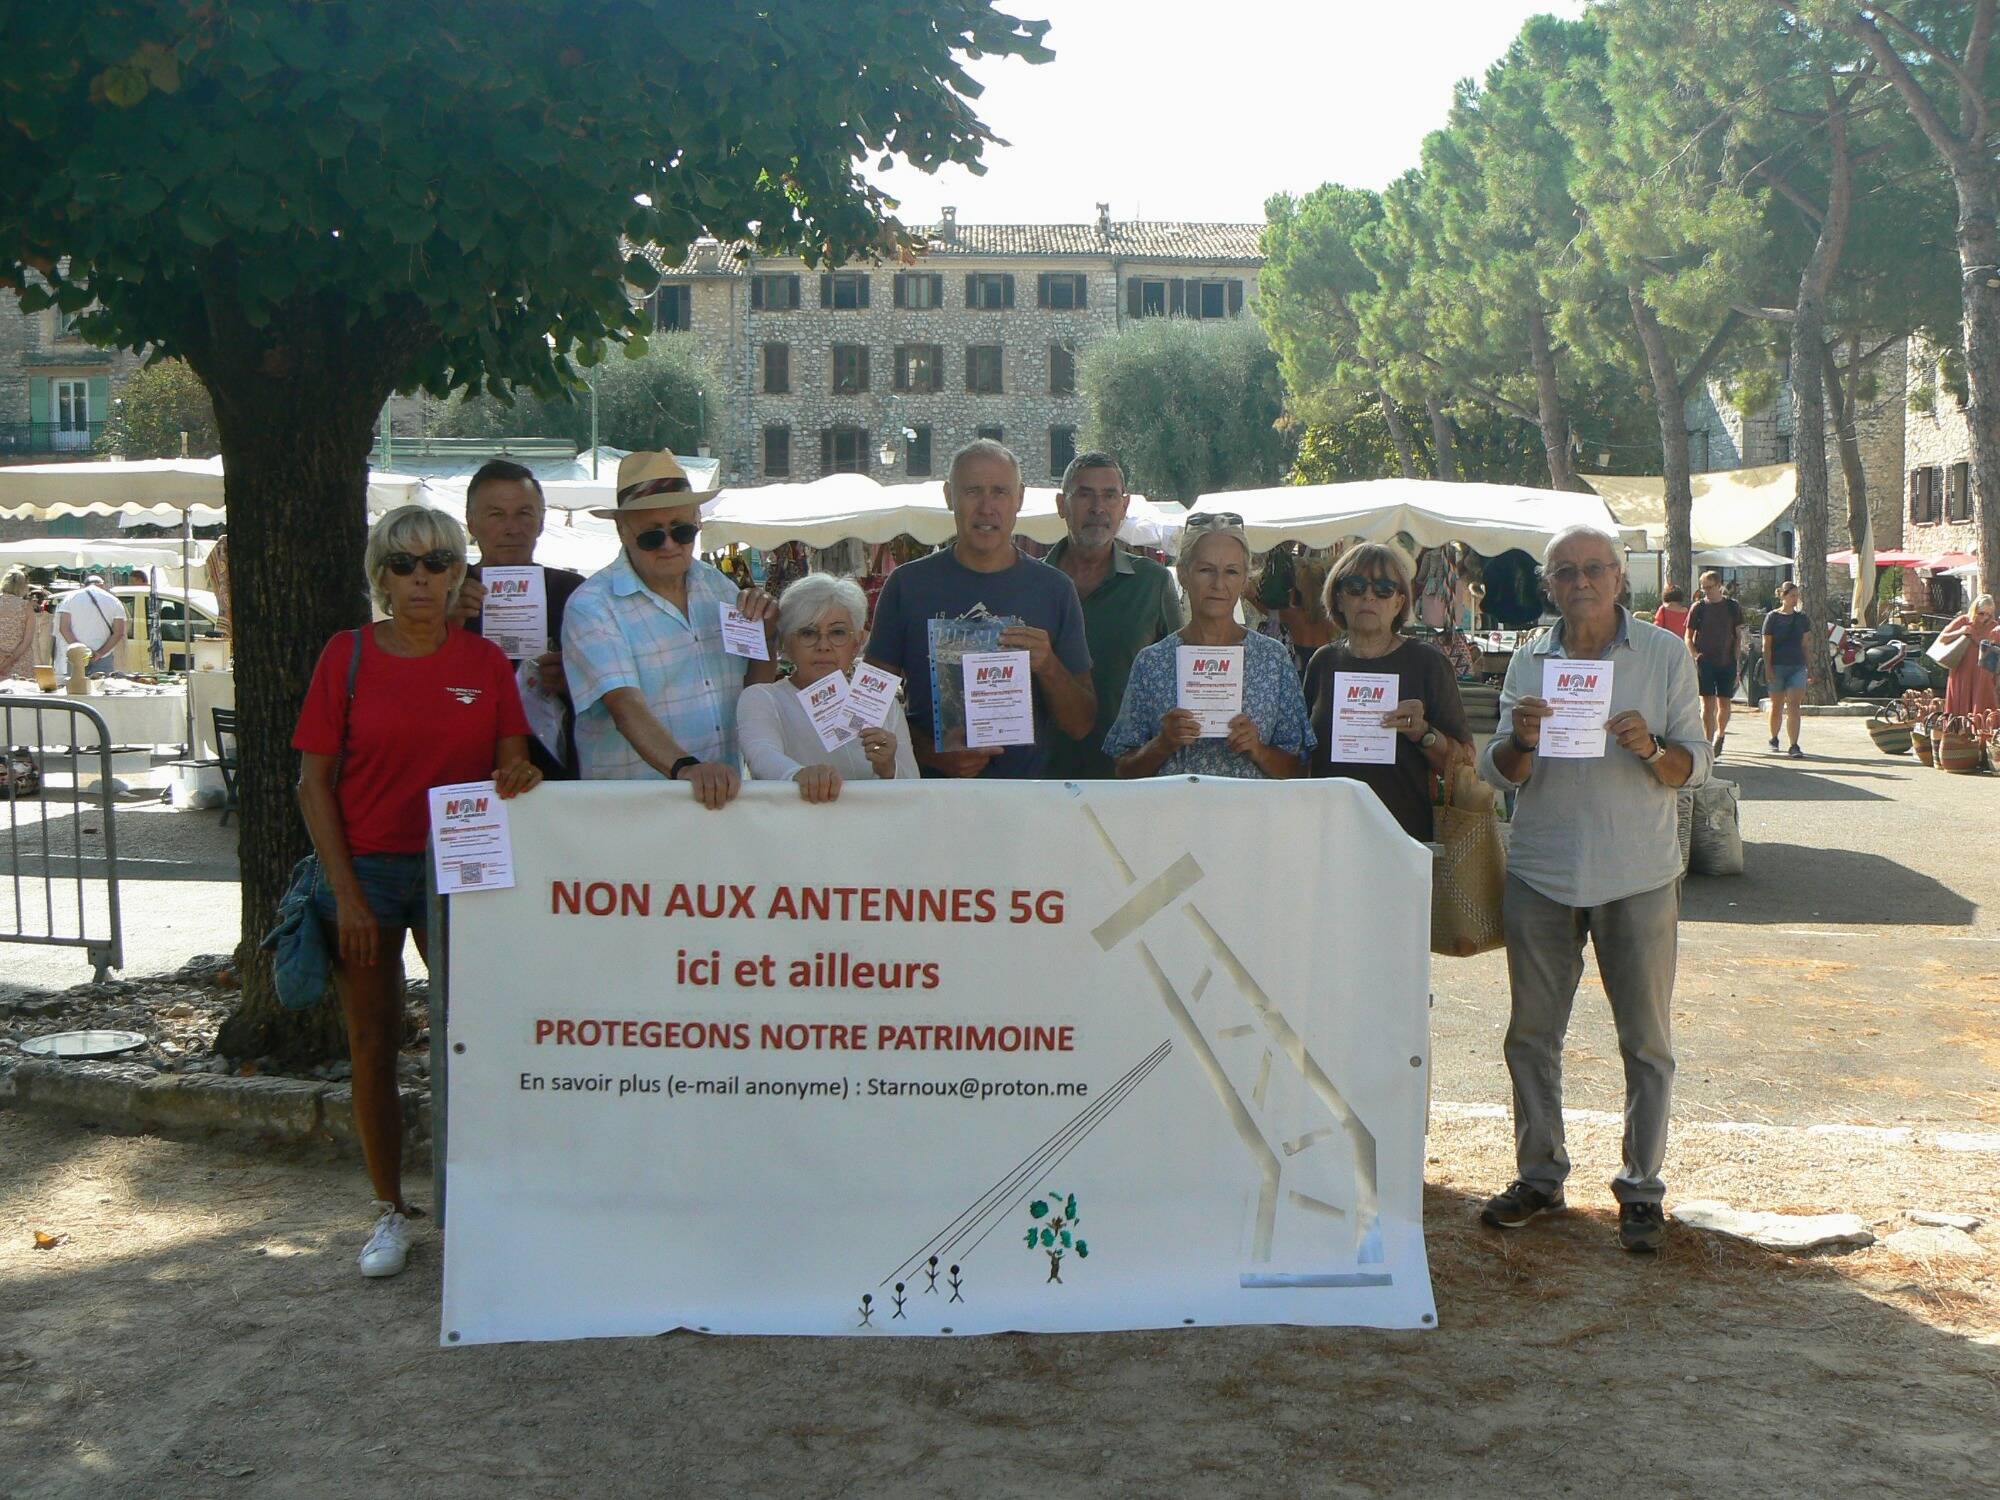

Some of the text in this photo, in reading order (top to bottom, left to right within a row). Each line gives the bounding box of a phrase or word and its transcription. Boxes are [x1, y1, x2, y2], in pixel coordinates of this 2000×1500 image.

[491, 580, 529, 593] NON
[977, 666, 1014, 680] NON
[1193, 659, 1231, 672] NON
[860, 674, 888, 692] NON
[1557, 674, 1598, 688] NON
[810, 684, 837, 705] NON
[1347, 686, 1385, 700] NON
[446, 798, 489, 815] NON
[552, 881, 1065, 924] NON AUX ANTENNES 5G
[677, 949, 940, 989] ici et ailleurs
[536, 1019, 1075, 1052] PROTEGEONS NOTRE PATRIMOINE
[520, 1073, 545, 1090] En
[551, 1073, 613, 1092] savoir
[619, 1074, 661, 1096] plus
[667, 1074, 739, 1098] (e-mail
[745, 1077, 849, 1100] anonyme)
[867, 1077, 1088, 1098] Starnoux@proton.me
